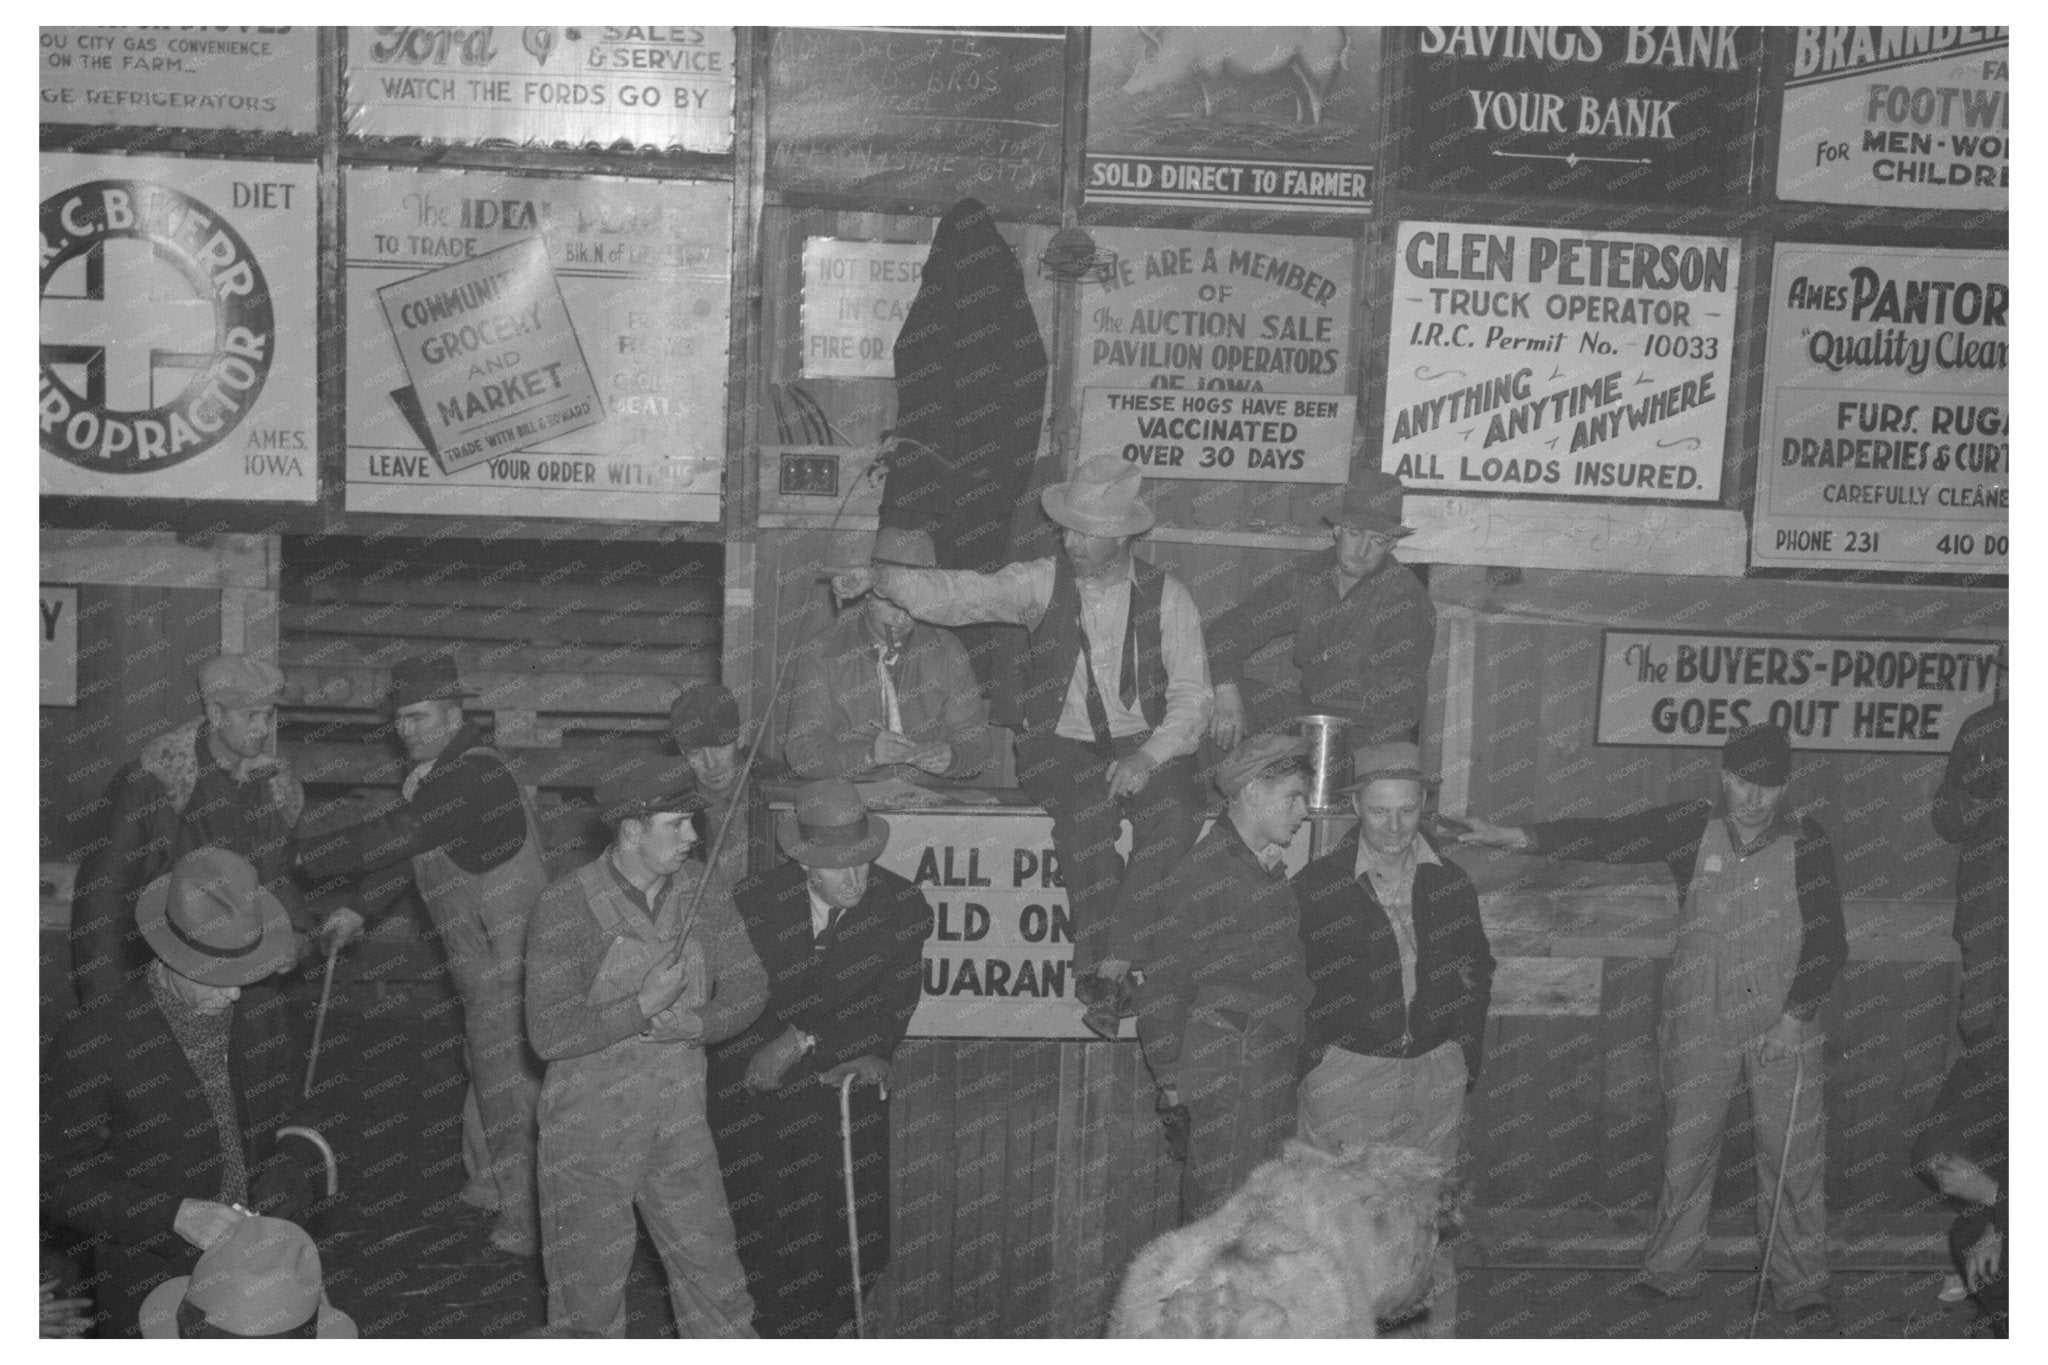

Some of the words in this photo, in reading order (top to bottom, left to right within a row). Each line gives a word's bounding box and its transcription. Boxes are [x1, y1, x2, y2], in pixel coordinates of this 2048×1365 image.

[49, 53, 71, 69] ON
[83, 54, 113, 70] THE
[77, 35, 115, 50] CITY
[123, 37, 157, 52] GAS
[168, 38, 272, 56] CONVENIENCE
[587, 47, 605, 69] &
[612, 48, 723, 72] SERVICE
[1420, 26, 1603, 63] SAVINGS
[1625, 26, 1741, 70] BANK
[86, 89, 277, 113] REFRIGERATORS
[381, 77, 456, 101] WATCH
[467, 80, 512, 103] THE
[524, 81, 605, 106] FORDS
[618, 84, 660, 108] GO
[673, 87, 709, 110] BY
[1468, 90, 1567, 133] YOUR
[1577, 96, 1680, 139] BANK
[1817, 141, 1850, 167] FOR
[232, 182, 295, 210] DIET
[1091, 162, 1153, 189] SOLD
[1161, 164, 1243, 192] DIRECT
[1251, 168, 1276, 194] TO
[1283, 169, 1366, 198] FARMER
[401, 191, 454, 229] The
[374, 234, 400, 256] TO
[407, 236, 477, 258] TRADE
[1406, 231, 1515, 283] GLEN
[1528, 237, 1729, 293] PETERSON
[819, 257, 857, 281] NOT
[1145, 247, 1193, 281] ARE
[1201, 246, 1218, 274] A
[1229, 248, 1337, 309] MEMBER
[838, 296, 859, 321] IN
[1198, 284, 1233, 304] OF
[1429, 287, 1531, 320] TRUCK
[1546, 294, 1691, 327] OPERATOR
[1788, 276, 1848, 312] AMES
[1093, 306, 1123, 334] The
[1129, 308, 1246, 340] AUCTION
[1260, 314, 1333, 343] SALE
[1410, 322, 1474, 348] I.R.C.
[1485, 326, 1568, 353] Permit
[1579, 331, 1618, 356] No.
[1644, 334, 1718, 360] 10033
[810, 335, 855, 360] FIRE
[859, 337, 884, 361] OR
[1092, 338, 1204, 370] PAVILION
[1211, 344, 1340, 376] OPERATORS
[468, 351, 521, 382] AND
[436, 361, 563, 427] MARKET
[1106, 393, 1176, 412] THESE
[1182, 396, 1234, 415] HOGS
[1241, 399, 1288, 417] HAVE
[1294, 400, 1339, 419] BEEN
[1392, 368, 1533, 445] ANYTHING
[1483, 370, 1623, 450] ANYTIME
[1137, 416, 1298, 444] VACCINATED
[1569, 371, 1715, 455] ANYWHERE
[444, 439, 484, 462] TRADE
[484, 428, 516, 448] WITH
[516, 421, 539, 438] BILL
[1122, 443, 1185, 468] OVER
[1198, 446, 1235, 468] 30
[1247, 448, 1306, 471] DAYS
[1781, 437, 1930, 471] DRAPERIES
[1932, 445, 1950, 471] &
[244, 455, 304, 477] IOWA
[369, 454, 430, 478] LEAVE
[488, 459, 531, 481] YOUR
[538, 460, 596, 484] ORDER
[1395, 453, 1444, 480] ALL
[1460, 457, 1560, 484] LOADS
[1574, 461, 1703, 490] INSURED.
[1823, 485, 1930, 506] CAREFULLY
[1776, 529, 1833, 551] PHONE
[1844, 531, 1879, 553] 231
[1936, 534, 1975, 556] 410
[1624, 643, 1668, 683] The
[1651, 697, 1752, 735] GOES
[1769, 700, 1839, 737] OUT
[1853, 701, 1943, 740] HERE
[913, 846, 991, 887] ALL
